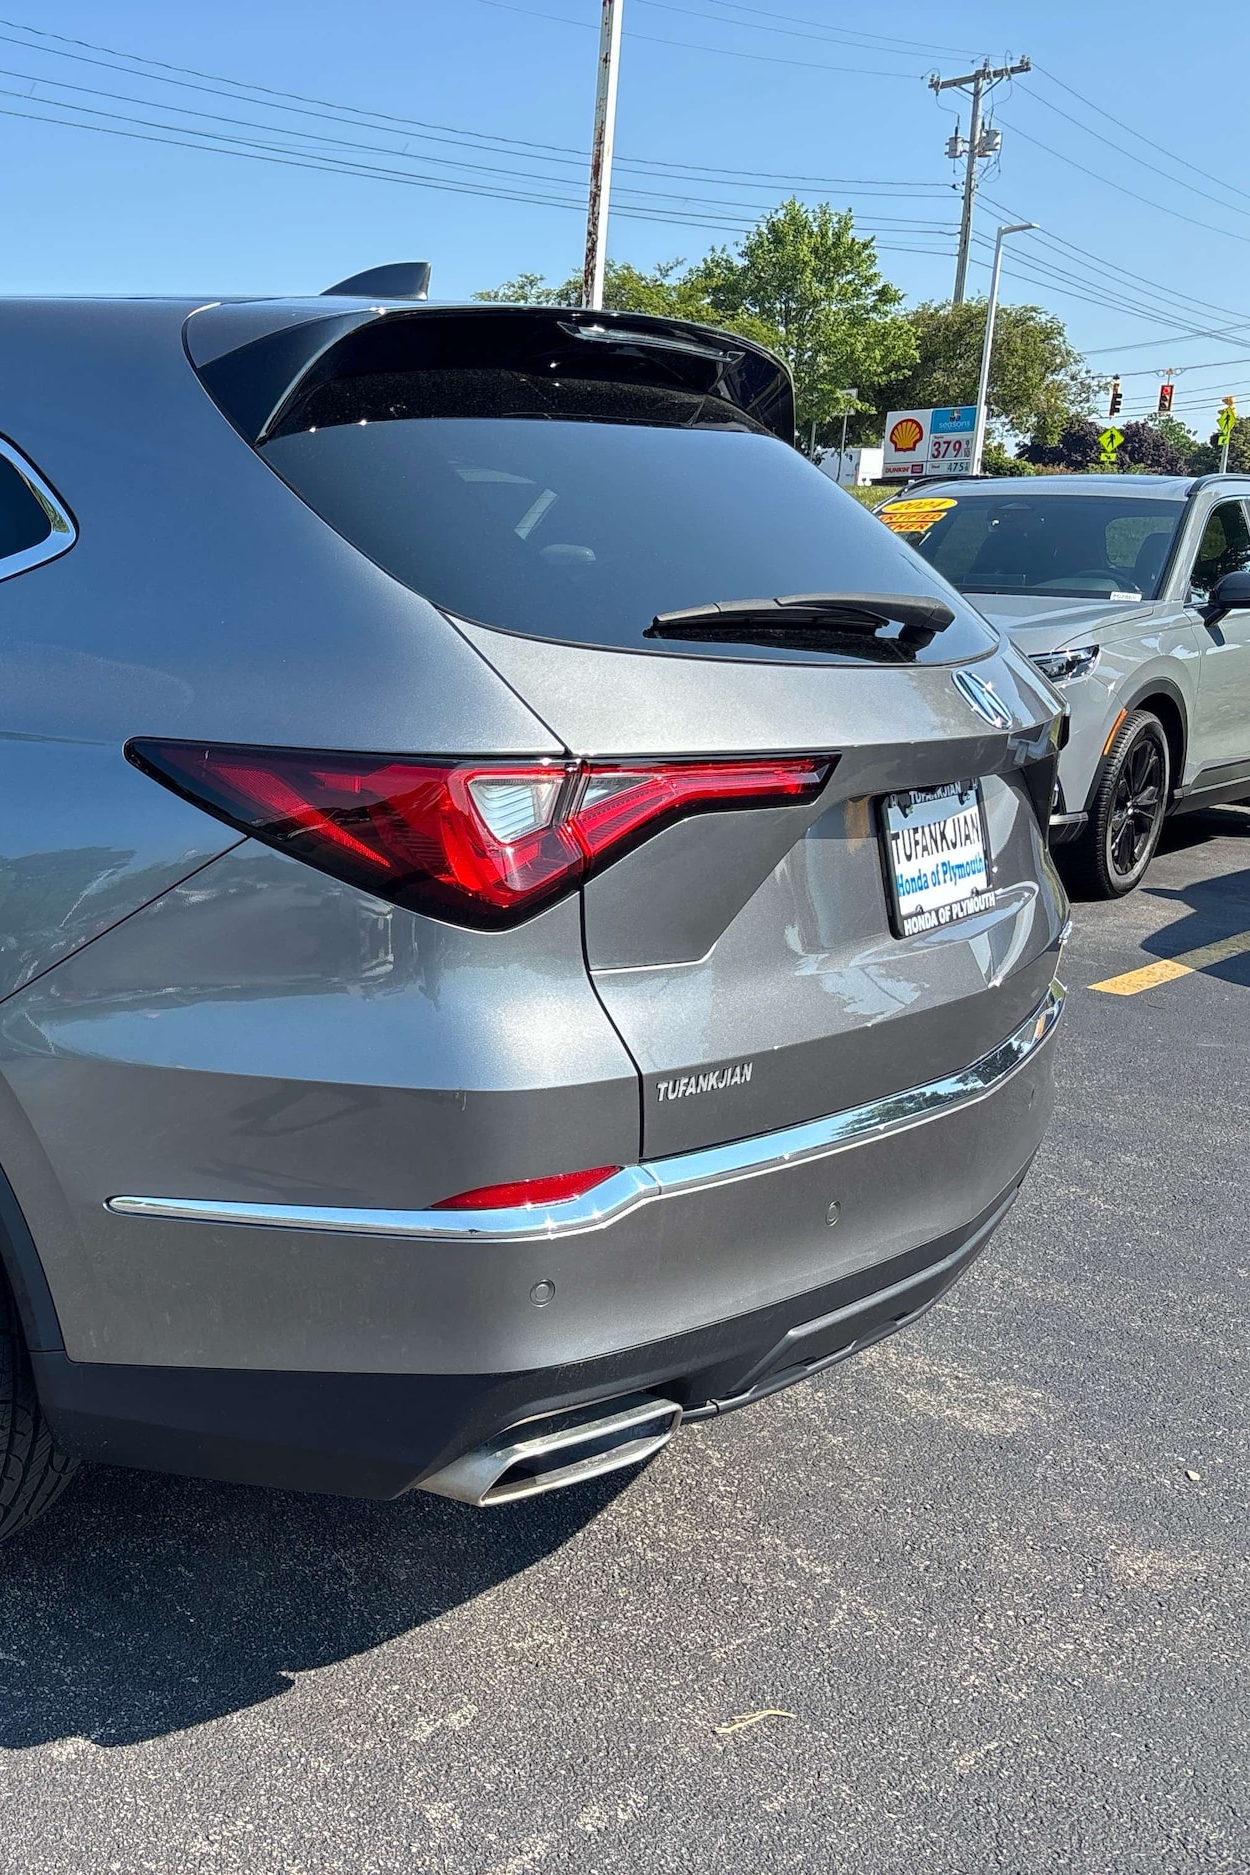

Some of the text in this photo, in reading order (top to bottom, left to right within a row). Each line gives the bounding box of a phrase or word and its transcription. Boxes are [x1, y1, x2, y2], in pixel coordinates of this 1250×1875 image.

[932, 440, 962, 458] 379
[948, 462, 964, 472] 475
[891, 813, 980, 864] TUFANKJIAN
[896, 853, 985, 897] Honda of Plymouth
[904, 892, 996, 936] HONDA OF PLYMOUTH
[657, 1062, 753, 1102] TUFANKJIAN
